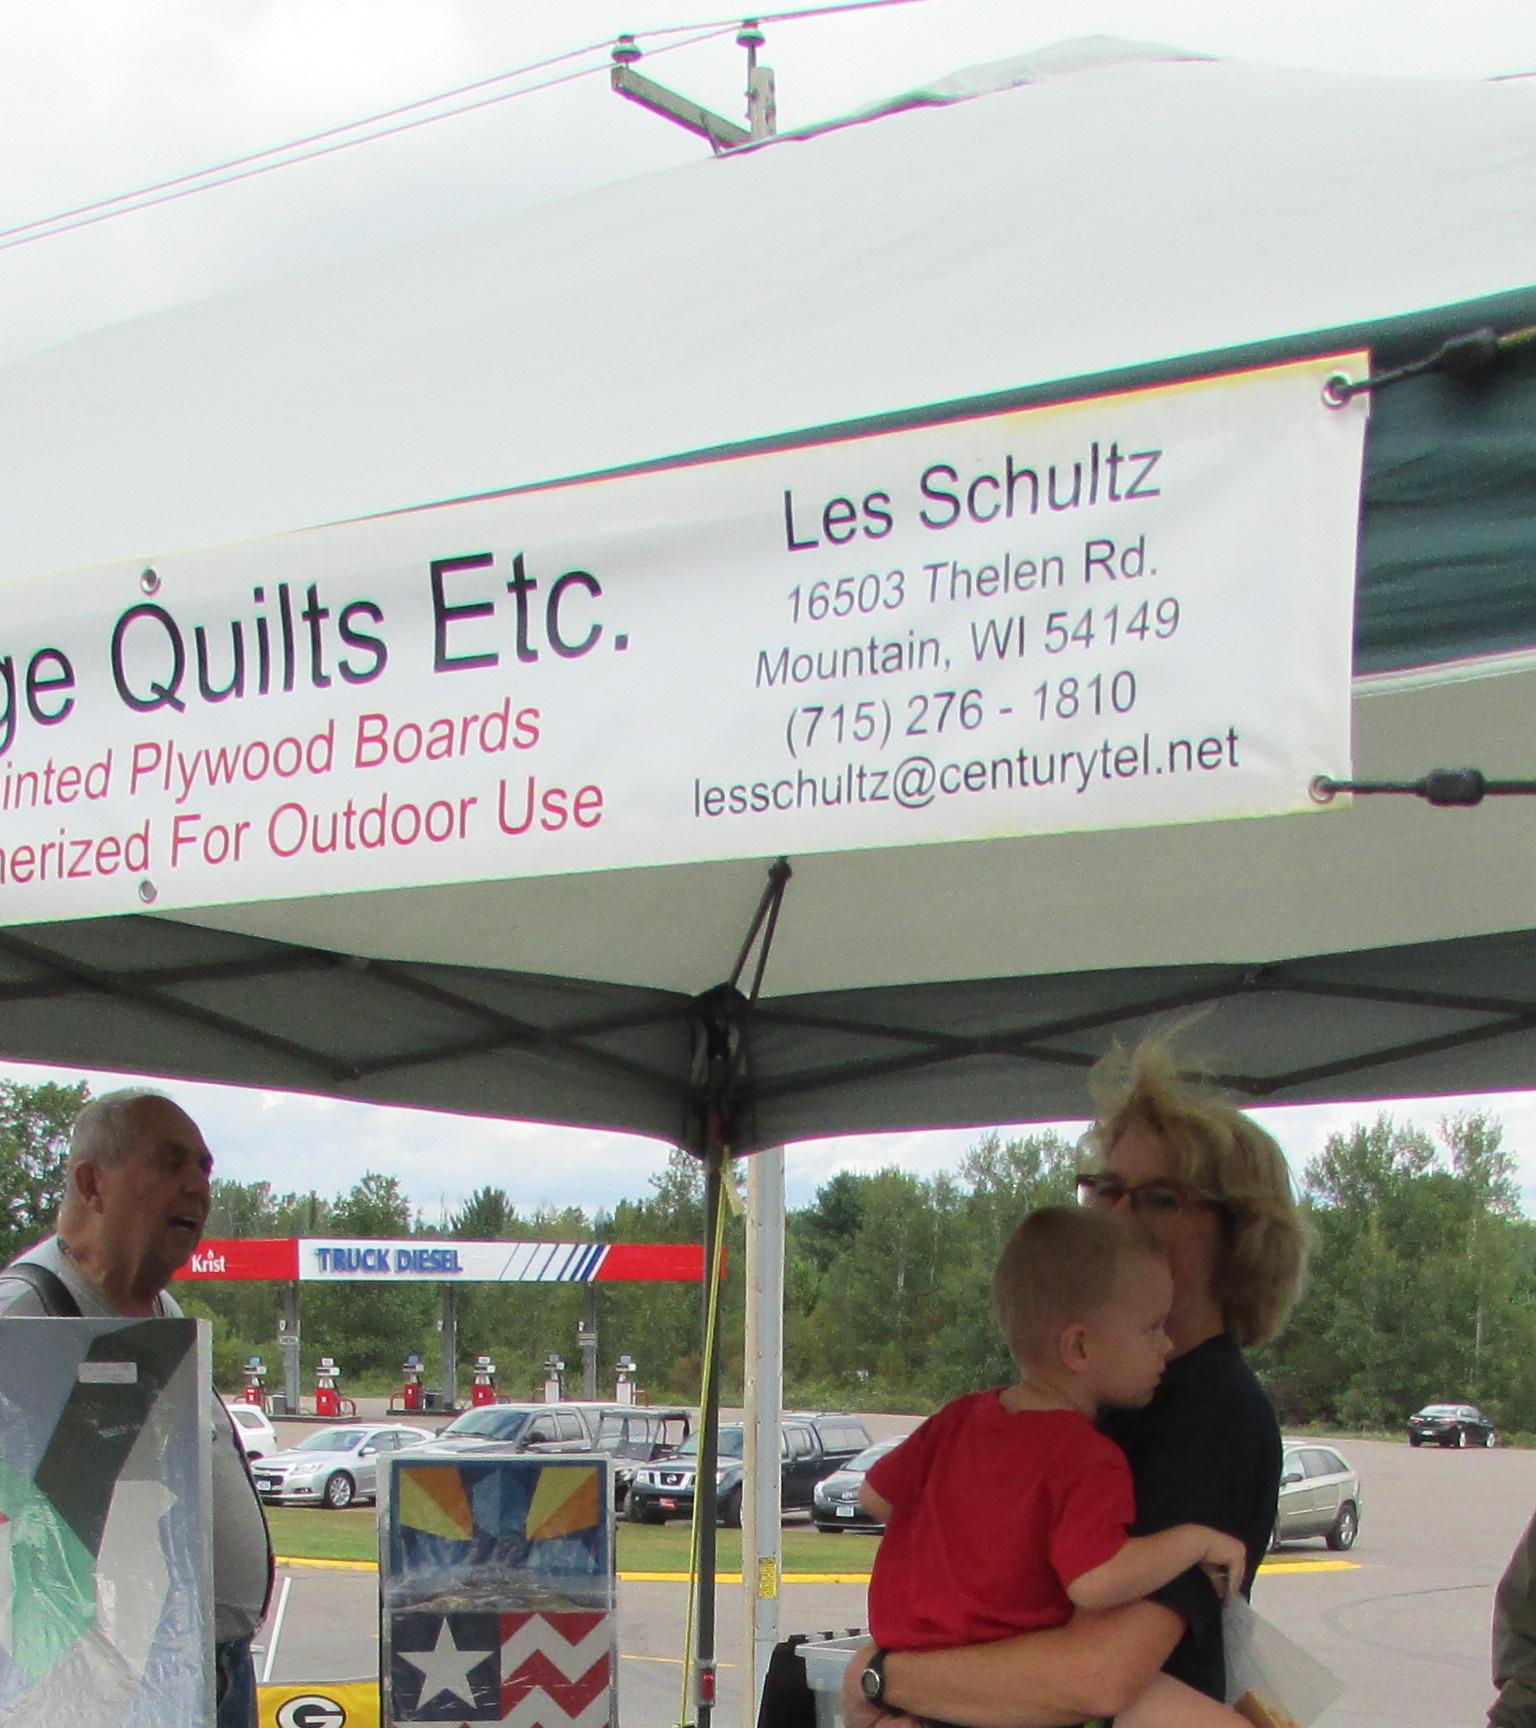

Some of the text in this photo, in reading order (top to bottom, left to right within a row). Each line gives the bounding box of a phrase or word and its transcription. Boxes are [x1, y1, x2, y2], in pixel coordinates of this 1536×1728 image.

[784, 441, 1163, 552] Les Schultz
[786, 534, 1158, 624] 16503 Thelen Rd.
[110, 581, 389, 714] Quilts
[429, 550, 630, 674] Etc.
[754, 596, 1181, 688] Mountain, WI 54149
[129, 717, 336, 805] Plywood
[353, 696, 542, 769] Boards
[785, 698, 892, 759] (715)
[905, 688, 984, 738] 276
[1032, 669, 1137, 722] 1810
[694, 726, 1240, 819] lesschultz@centurytel.net
[170, 813, 251, 869] For
[267, 791, 479, 858] Outdoor
[497, 775, 604, 836] Use
[191, 1250, 227, 1274] Krist
[317, 1247, 464, 1275] TRUCK DIESEL
